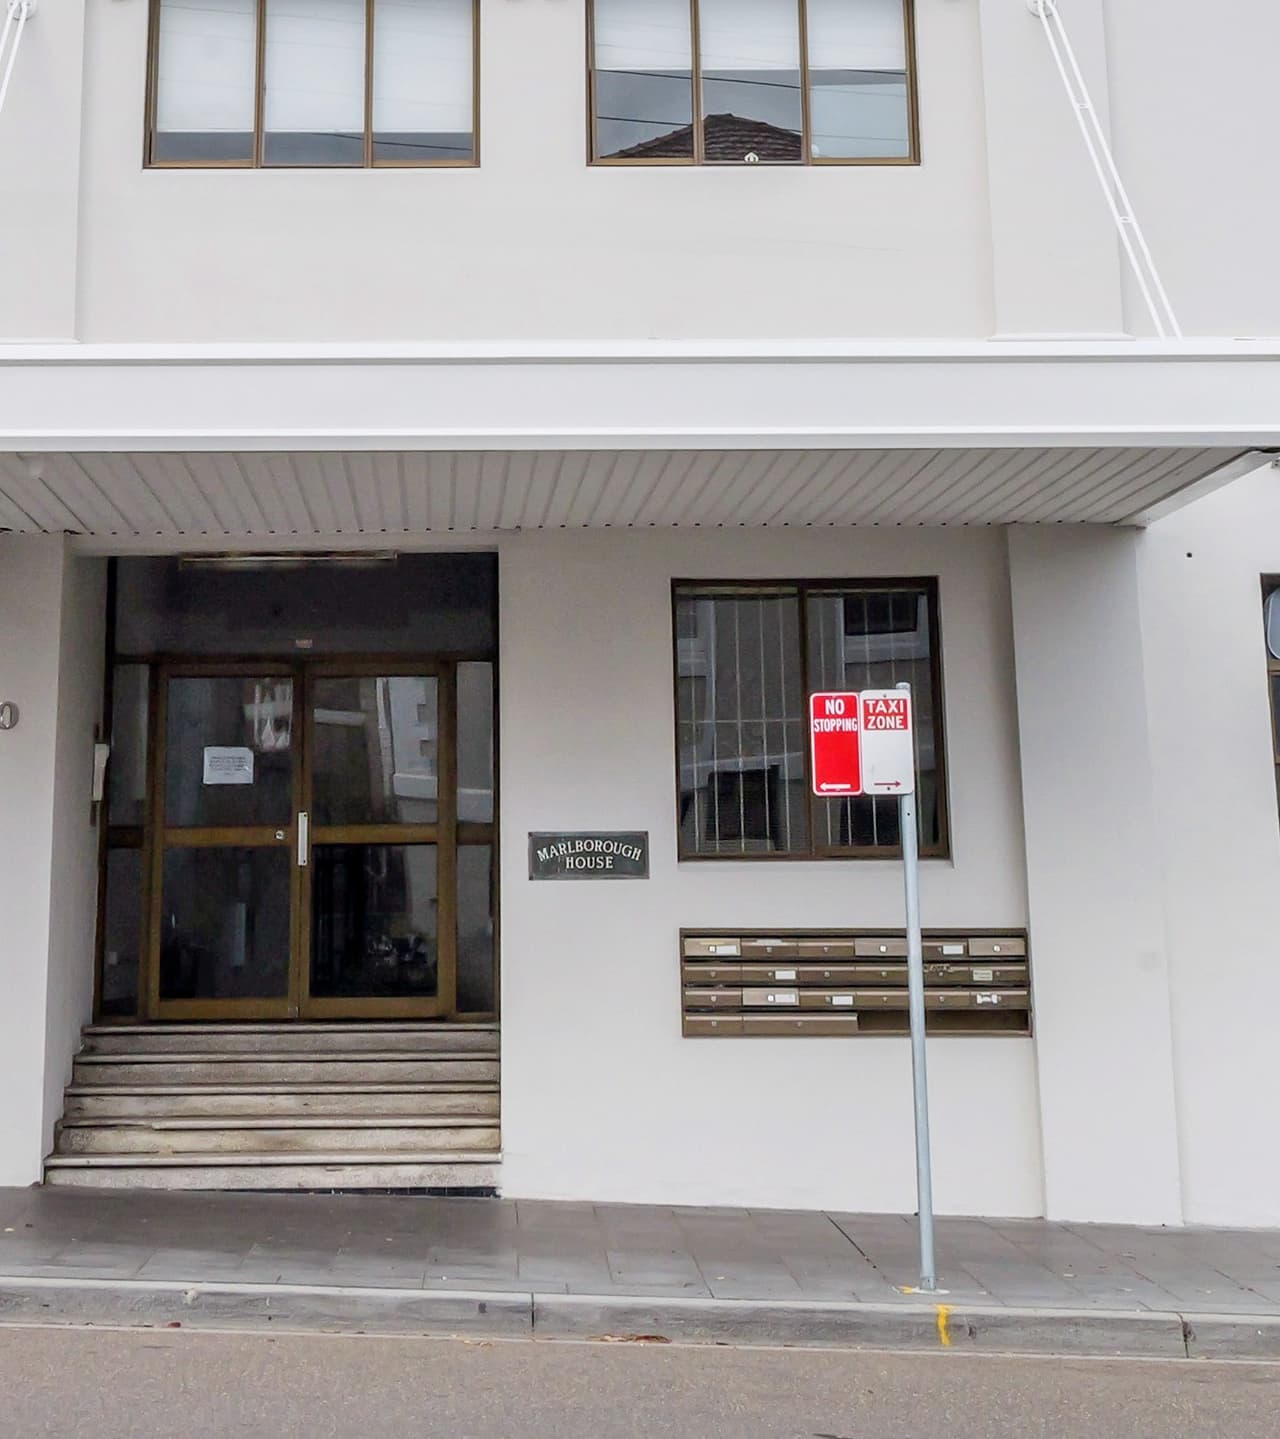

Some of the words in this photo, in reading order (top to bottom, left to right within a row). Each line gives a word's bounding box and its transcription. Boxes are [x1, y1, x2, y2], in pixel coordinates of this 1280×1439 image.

[825, 699, 845, 715] NO
[866, 700, 904, 713] TAXI
[814, 718, 858, 732] STOPPING
[867, 716, 904, 729] ZONE
[536, 839, 642, 862] MARLBOROUGH
[565, 856, 614, 869] HOUSE
